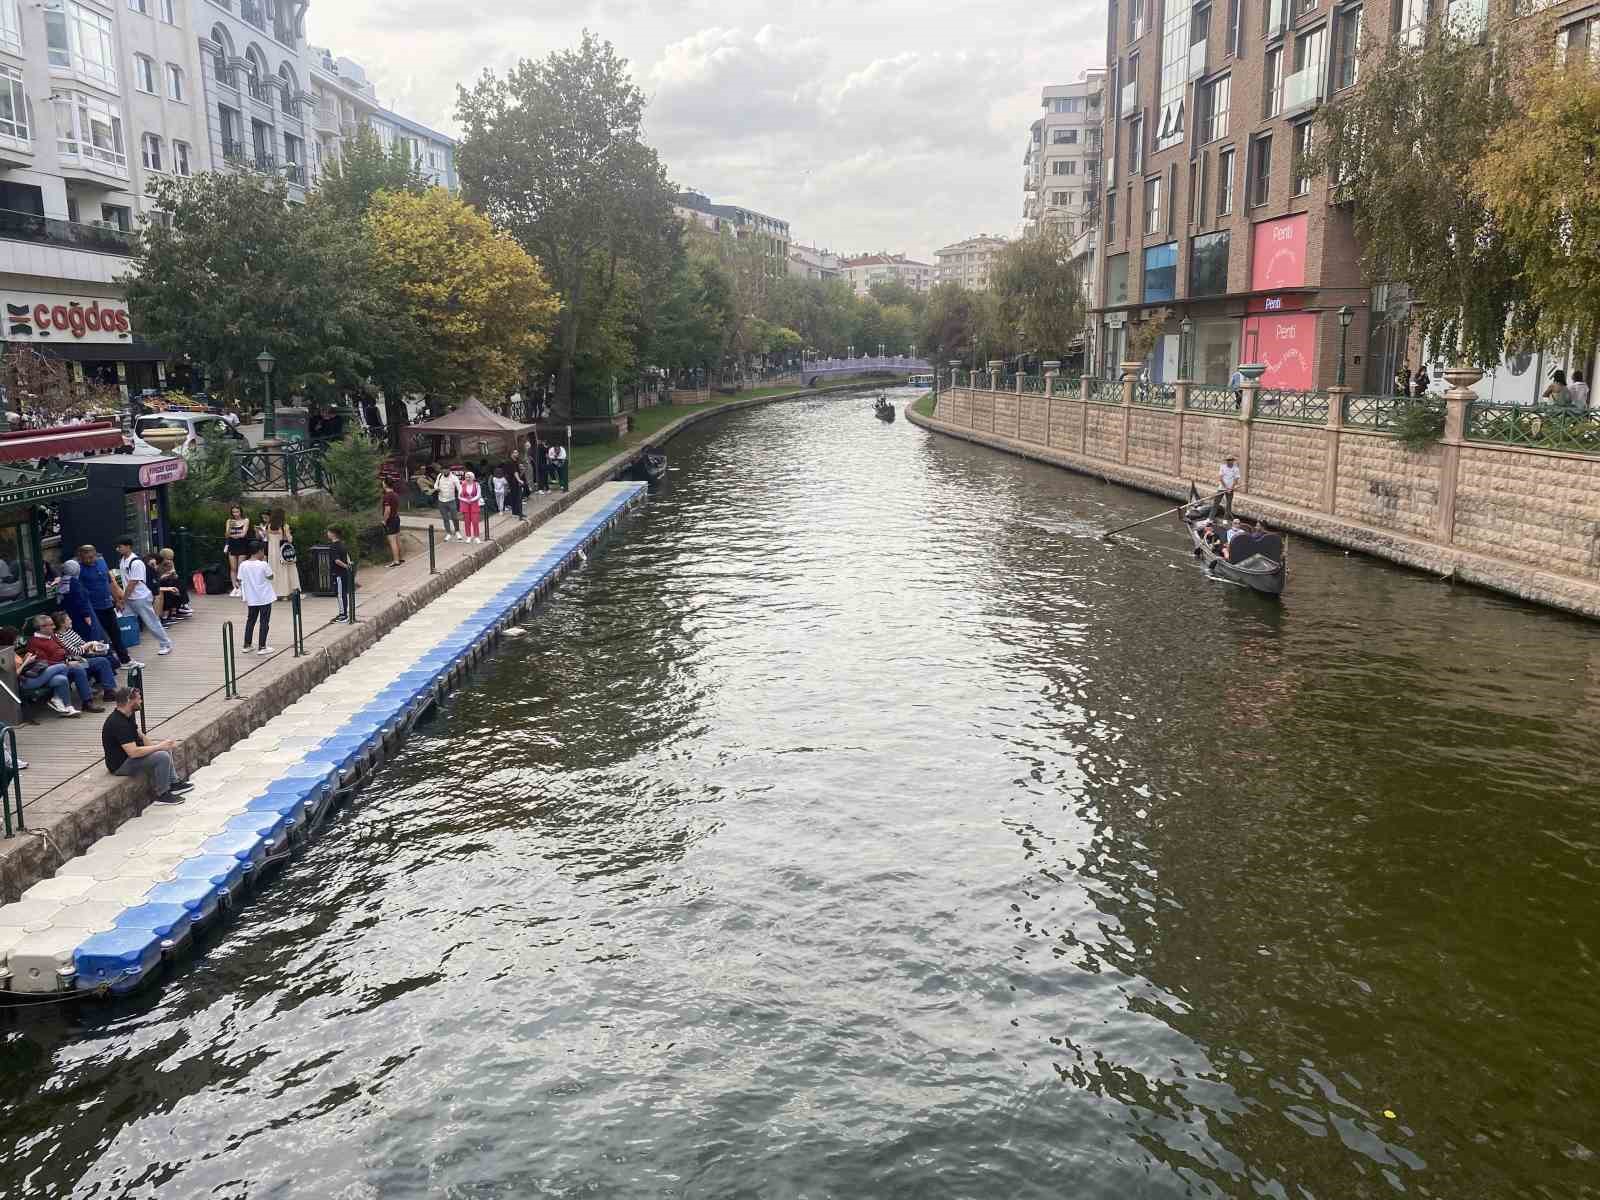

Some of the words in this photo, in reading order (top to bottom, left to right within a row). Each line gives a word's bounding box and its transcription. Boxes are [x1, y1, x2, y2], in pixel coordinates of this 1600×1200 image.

[1272, 224, 1294, 241] Penti
[1265, 297, 1281, 310] Penti
[1275, 324, 1296, 339] Penti
